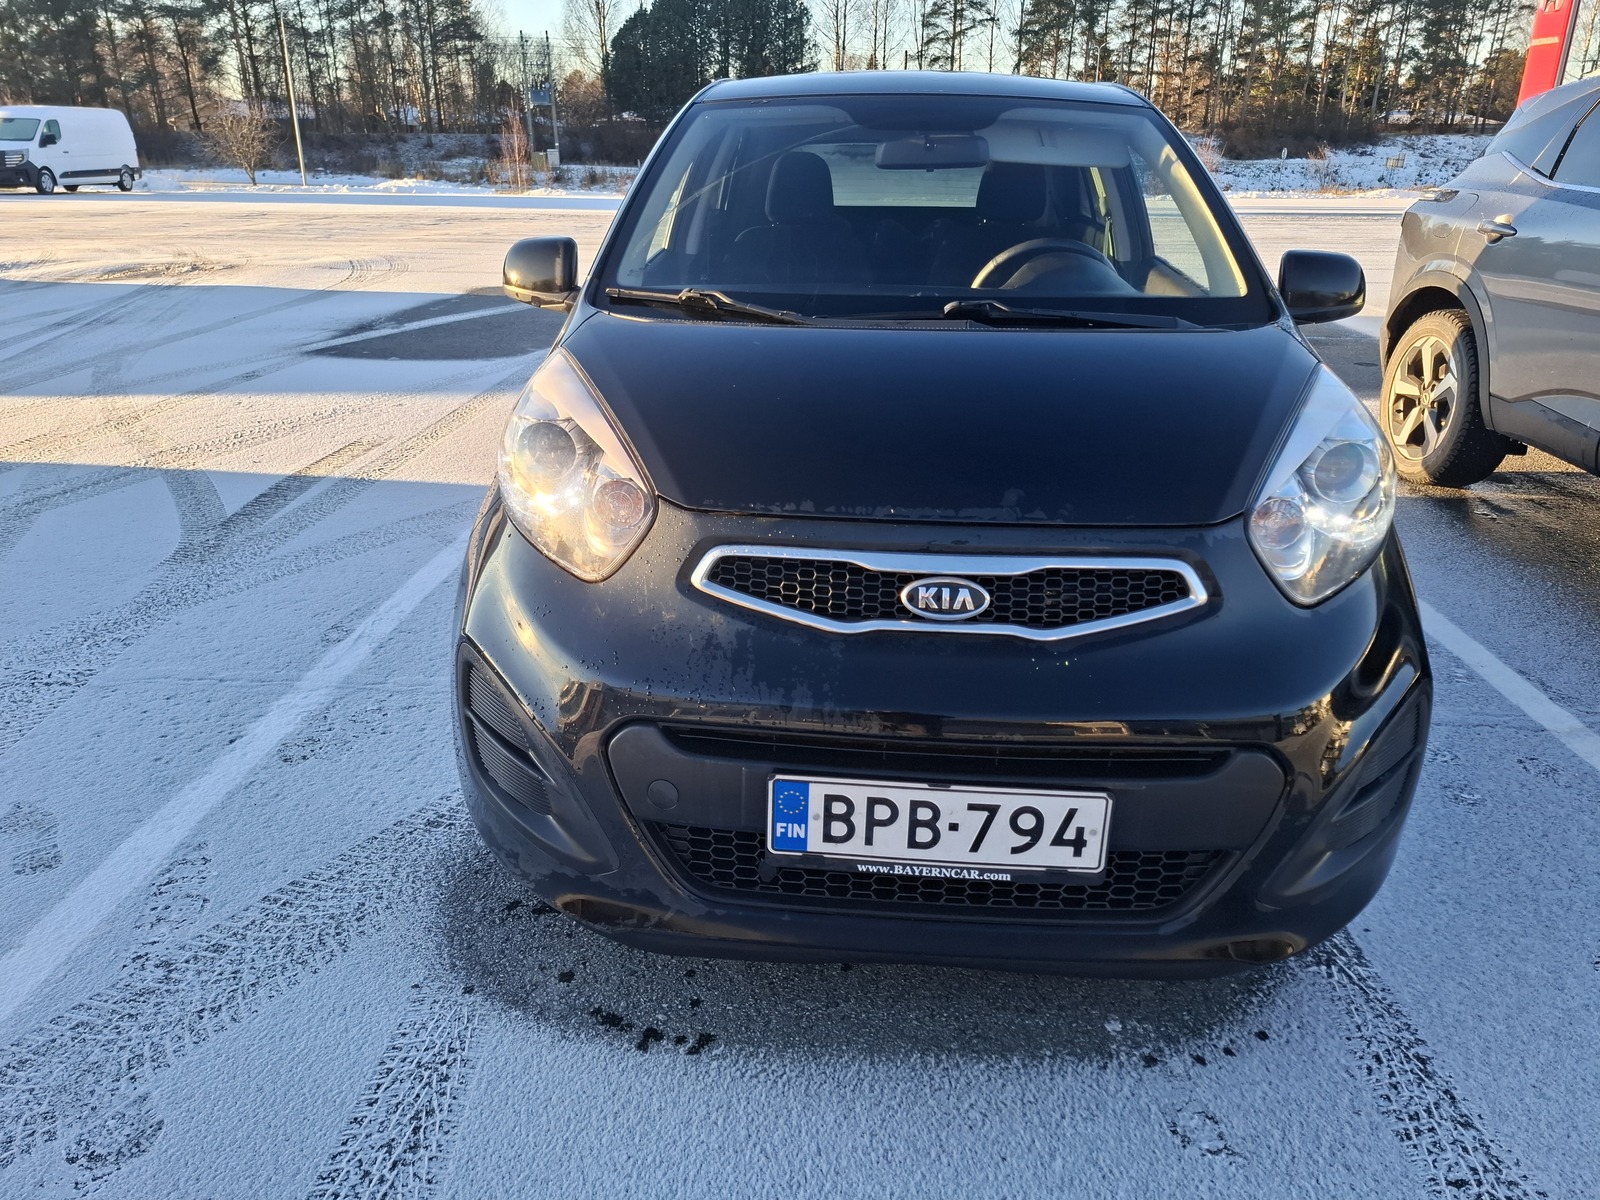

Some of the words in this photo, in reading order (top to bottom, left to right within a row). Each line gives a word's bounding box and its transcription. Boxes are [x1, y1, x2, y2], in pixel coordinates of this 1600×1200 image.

[918, 586, 975, 610] KIA
[776, 823, 806, 838] FIN
[822, 794, 1088, 857] BPB-794
[857, 864, 1011, 881] www.BAYERNCAR.com
